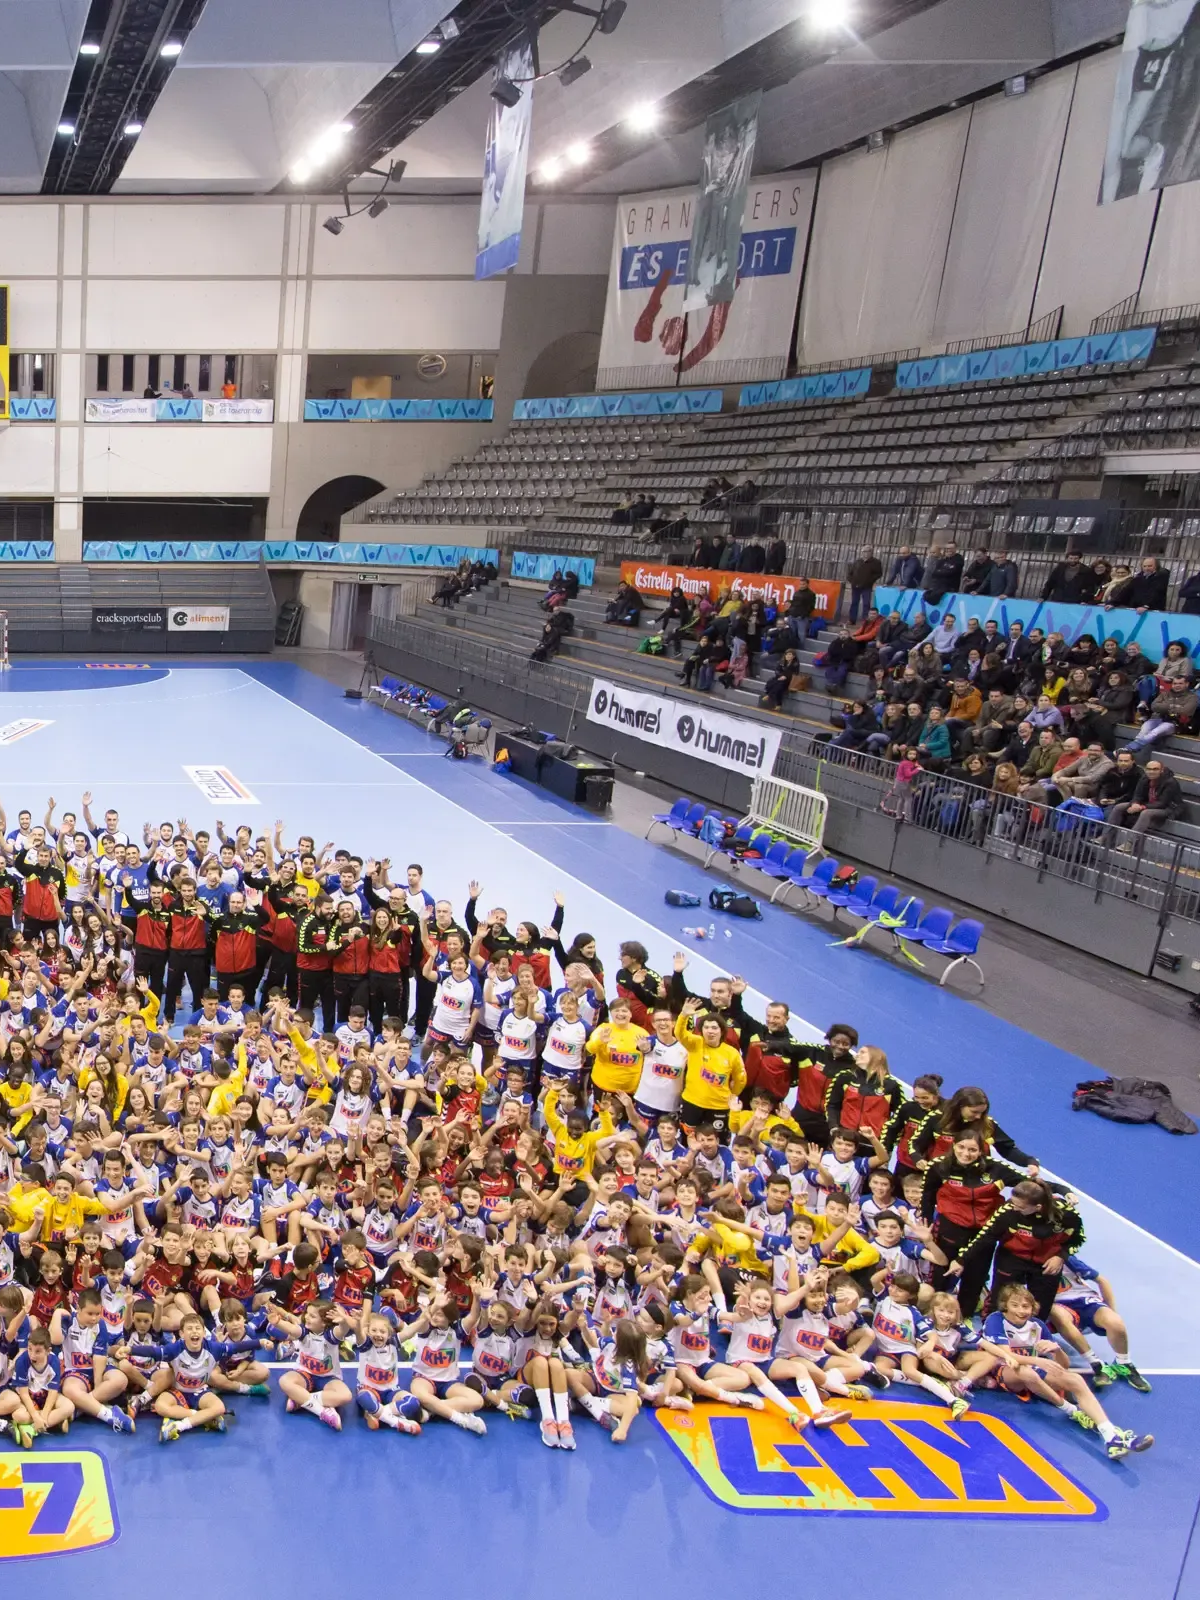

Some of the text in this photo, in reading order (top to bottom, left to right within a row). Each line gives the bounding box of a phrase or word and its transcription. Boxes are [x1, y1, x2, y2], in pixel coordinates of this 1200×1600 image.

[627, 187, 800, 235] GRANERS
[634, 567, 672, 590] Estrella
[784, 584, 828, 610] Dm
[96, 613, 162, 624] cracksportsclub
[609, 693, 662, 734] hummel
[694, 719, 766, 768] hummel
[443, 996, 464, 1010] KH-7
[507, 1037, 529, 1050] KH-7
[552, 1040, 576, 1054] KH-7
[611, 1052, 640, 1066] KH-7
[654, 1064, 683, 1079] KH-7
[701, 1068, 726, 1086] KH-7
[558, 1154, 584, 1170] KH-7
[108, 1209, 132, 1222] KH-7
[222, 1214, 247, 1227] KH-7
[875, 1315, 911, 1340] KH-7
[424, 1348, 456, 1364] KH-7
[301, 1357, 332, 1373] KH-7
[178, 1372, 208, 1387] KH-7
[708, 1415, 1070, 1502] KH-7
